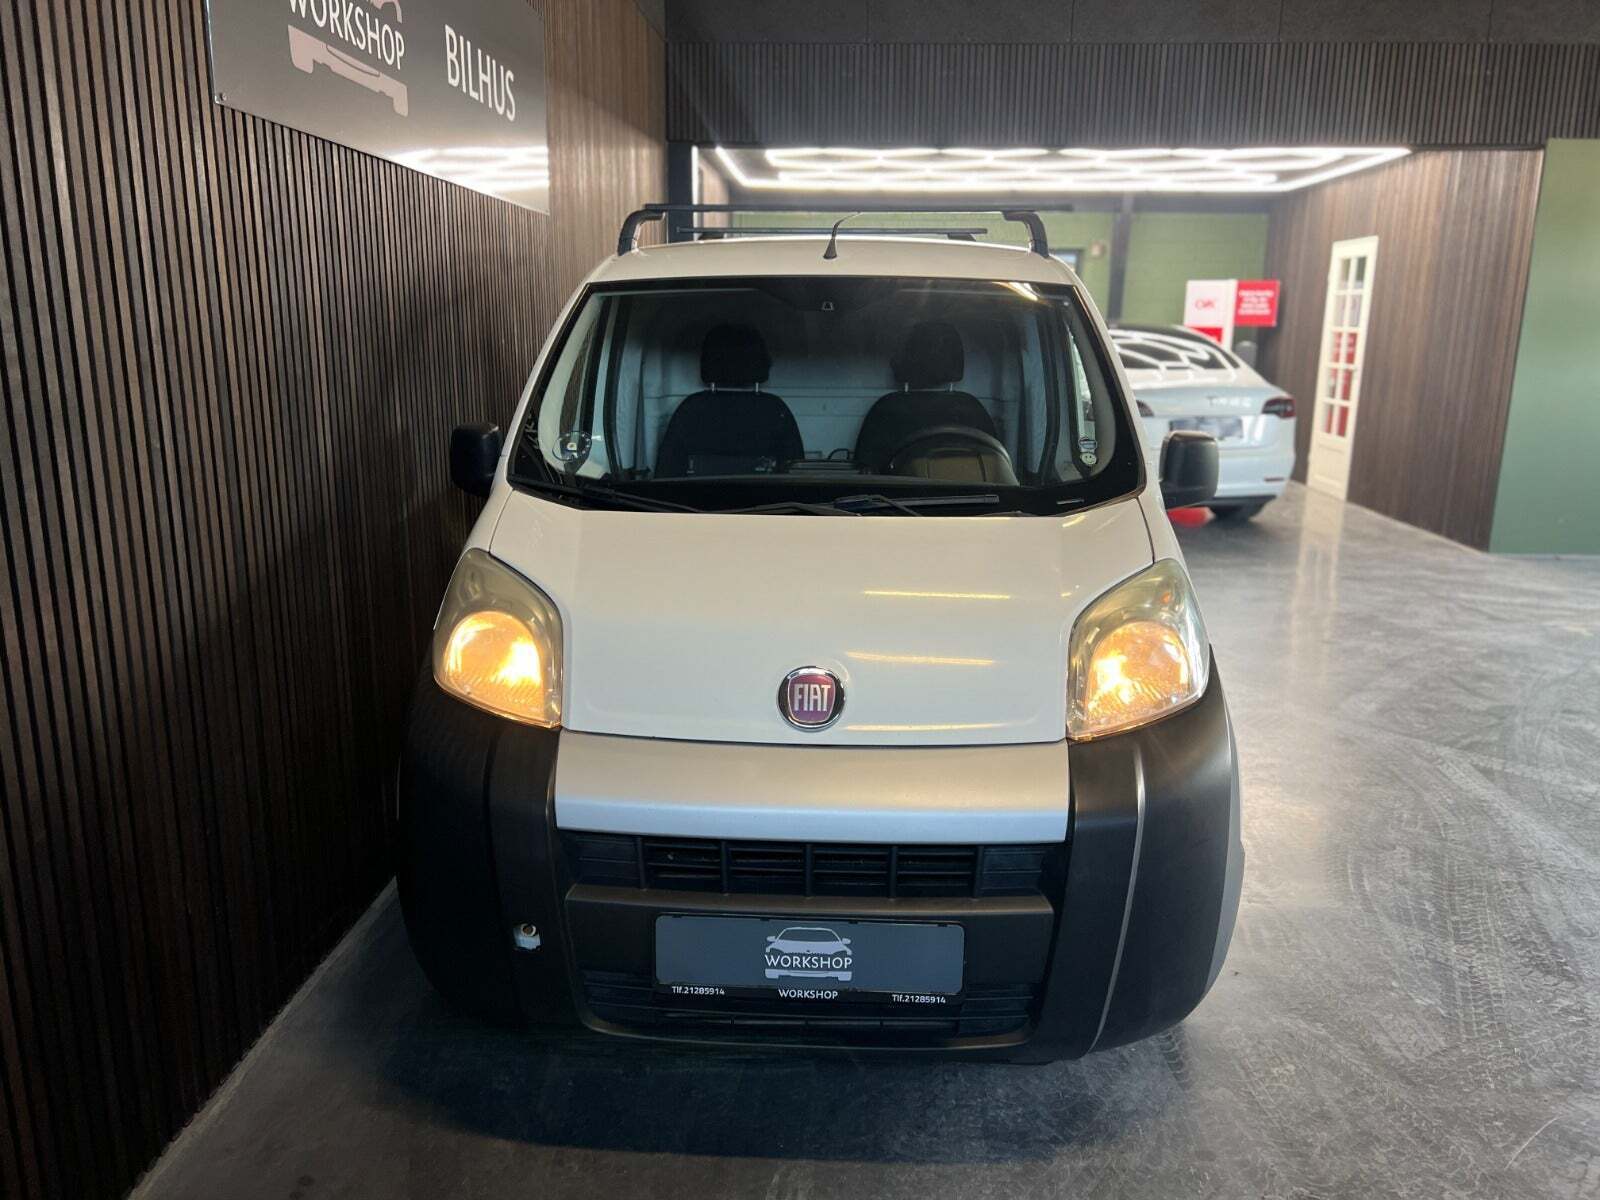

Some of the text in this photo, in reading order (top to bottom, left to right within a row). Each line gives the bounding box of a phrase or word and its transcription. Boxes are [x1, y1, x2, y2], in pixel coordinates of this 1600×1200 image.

[445, 24, 515, 121] BILHUS
[794, 683, 832, 712] FIAT
[765, 954, 852, 969] WORKSHOP
[672, 985, 725, 996] Tlf.21285914
[778, 988, 838, 1000] WORKSHOP
[892, 994, 946, 1004] Tlf.21285914
